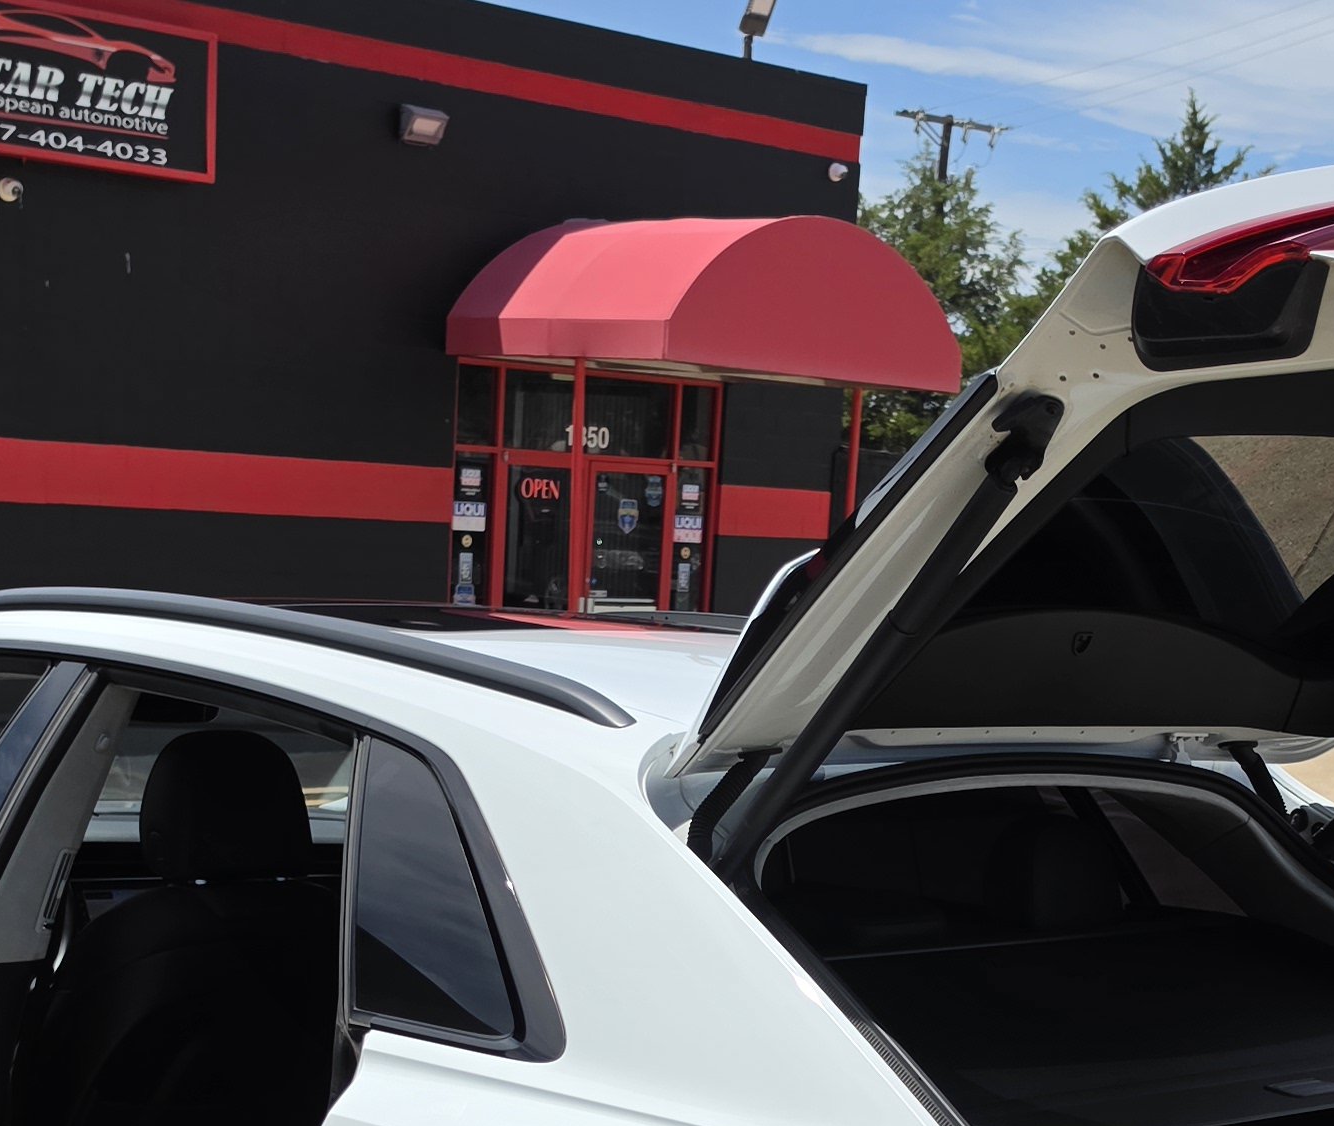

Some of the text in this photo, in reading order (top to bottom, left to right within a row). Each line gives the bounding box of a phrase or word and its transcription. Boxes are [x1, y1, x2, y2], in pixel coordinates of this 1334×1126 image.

[75, 73, 174, 120] TECH
[58, 106, 169, 135] automotive
[520, 477, 560, 500] OPEN
[454, 503, 485, 516] LIQUI
[675, 517, 702, 529] LIQUI
